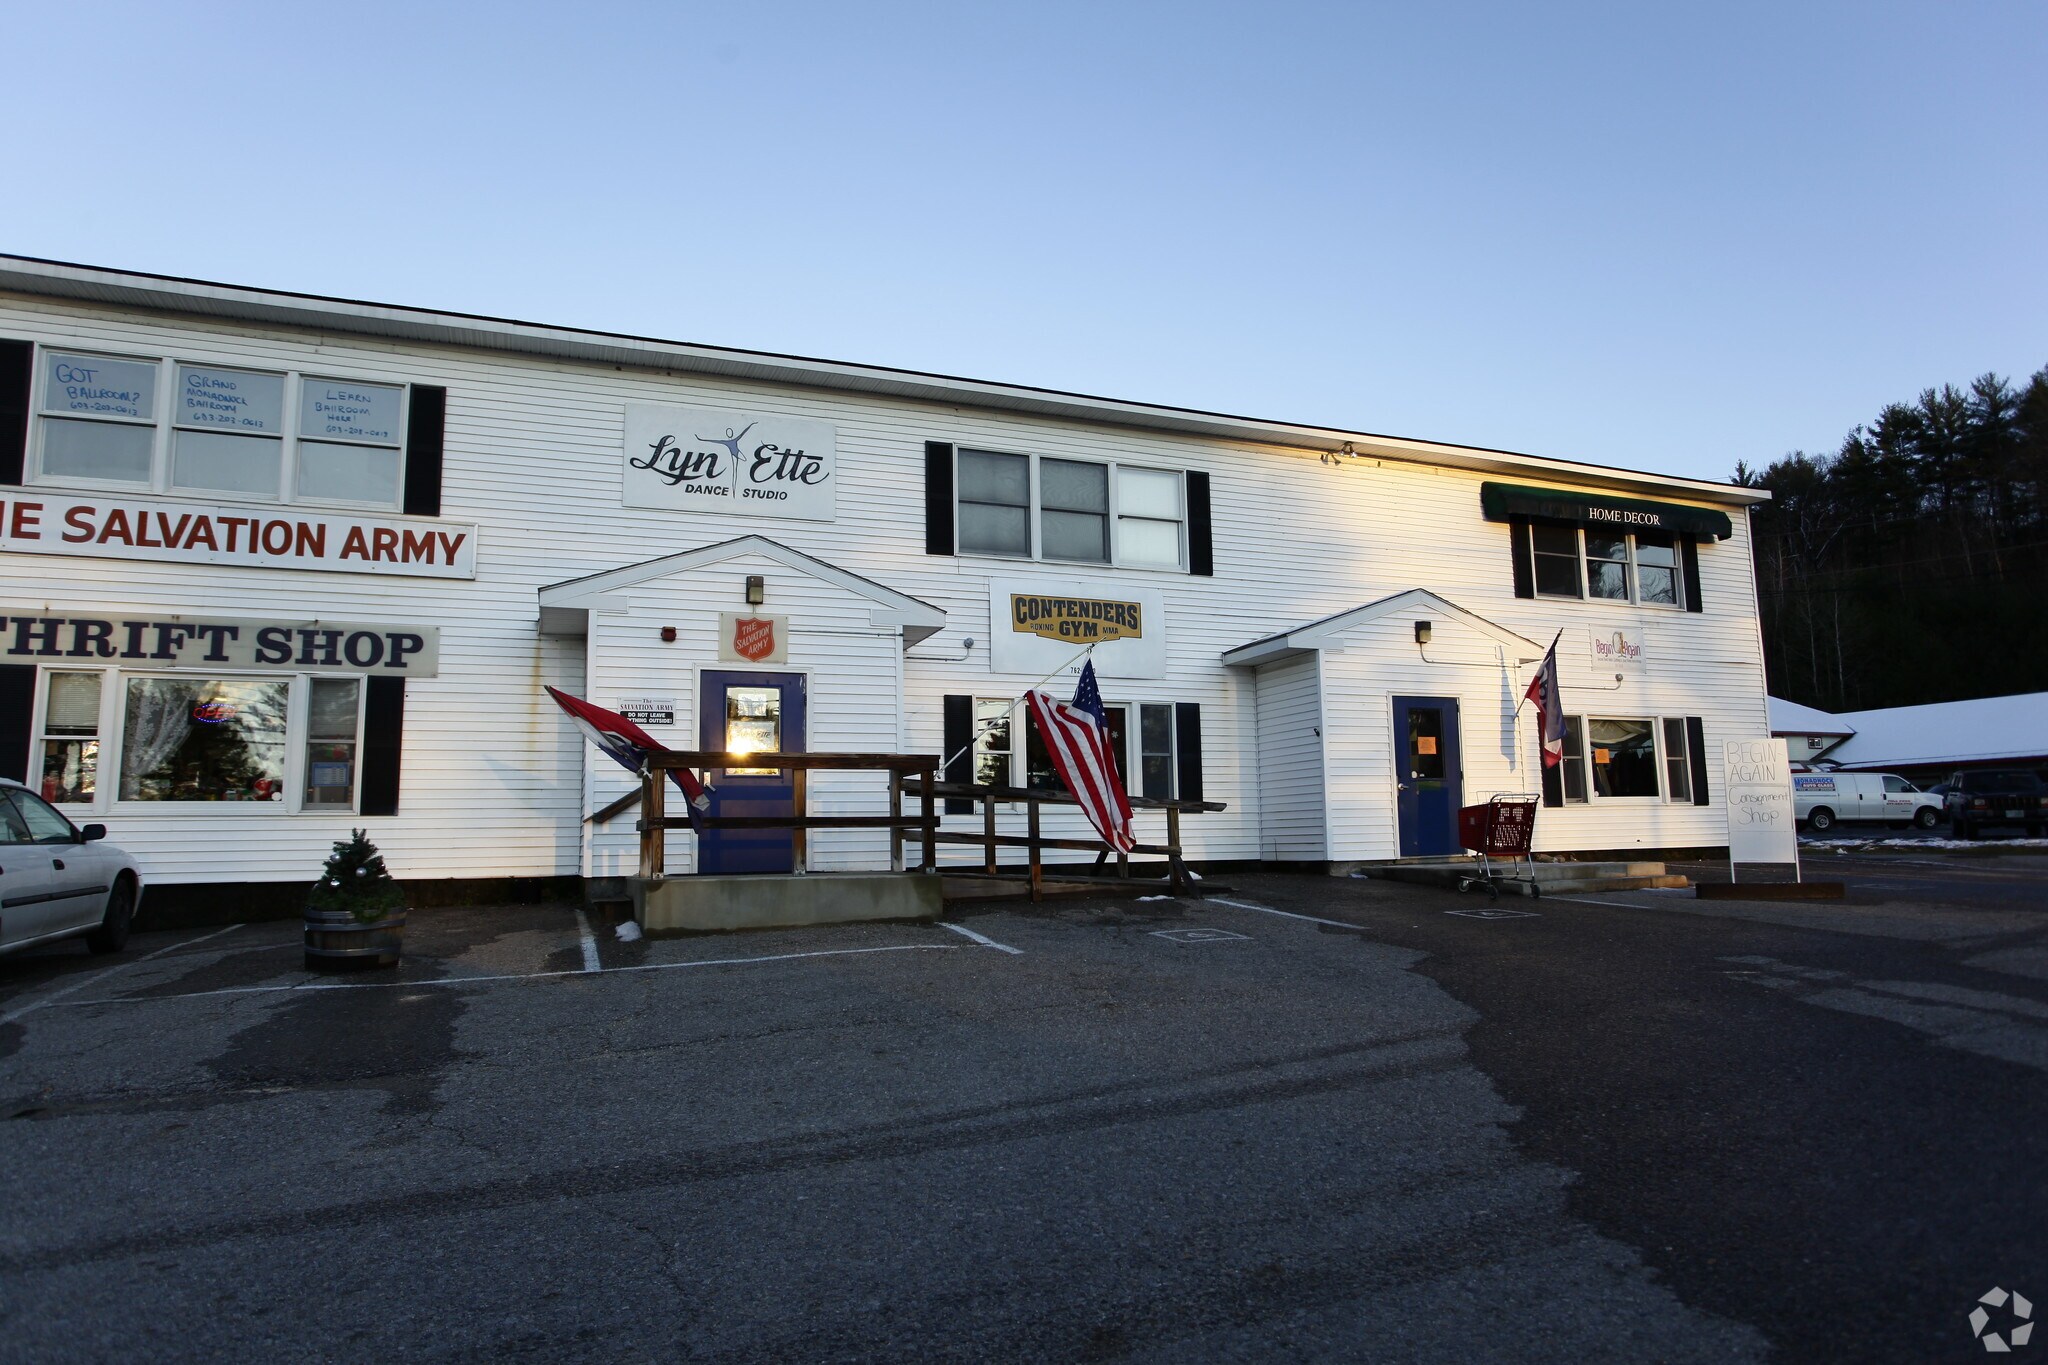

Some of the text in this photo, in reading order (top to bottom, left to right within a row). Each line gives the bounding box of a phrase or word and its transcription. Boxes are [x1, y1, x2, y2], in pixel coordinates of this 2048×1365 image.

[56, 364, 99, 383] GOT
[187, 374, 237, 390] GRAND
[66, 386, 141, 405] BALLROOM?
[187, 388, 248, 406] MONADNOCK
[326, 389, 371, 403] LEARN
[629, 434, 830, 486] Lyn Ette
[684, 483, 788, 501] DANCE STUDIO
[1589, 507, 1661, 526] HOME DECOR
[0, 500, 467, 567] E SALVATION ARMY
[1015, 597, 1138, 630] CONTENDERS
[736, 624, 770, 650] SALVATION
[742, 621, 757, 635] THE
[1058, 620, 1098, 637] GYM
[1102, 626, 1119, 635] MMA
[255, 626, 424, 668] SHOP
[748, 636, 769, 656] ARMY
[1595, 638, 1642, 659] Begin Again
[1729, 763, 1776, 782] AGAIN
[1738, 806, 1779, 826] Shop
